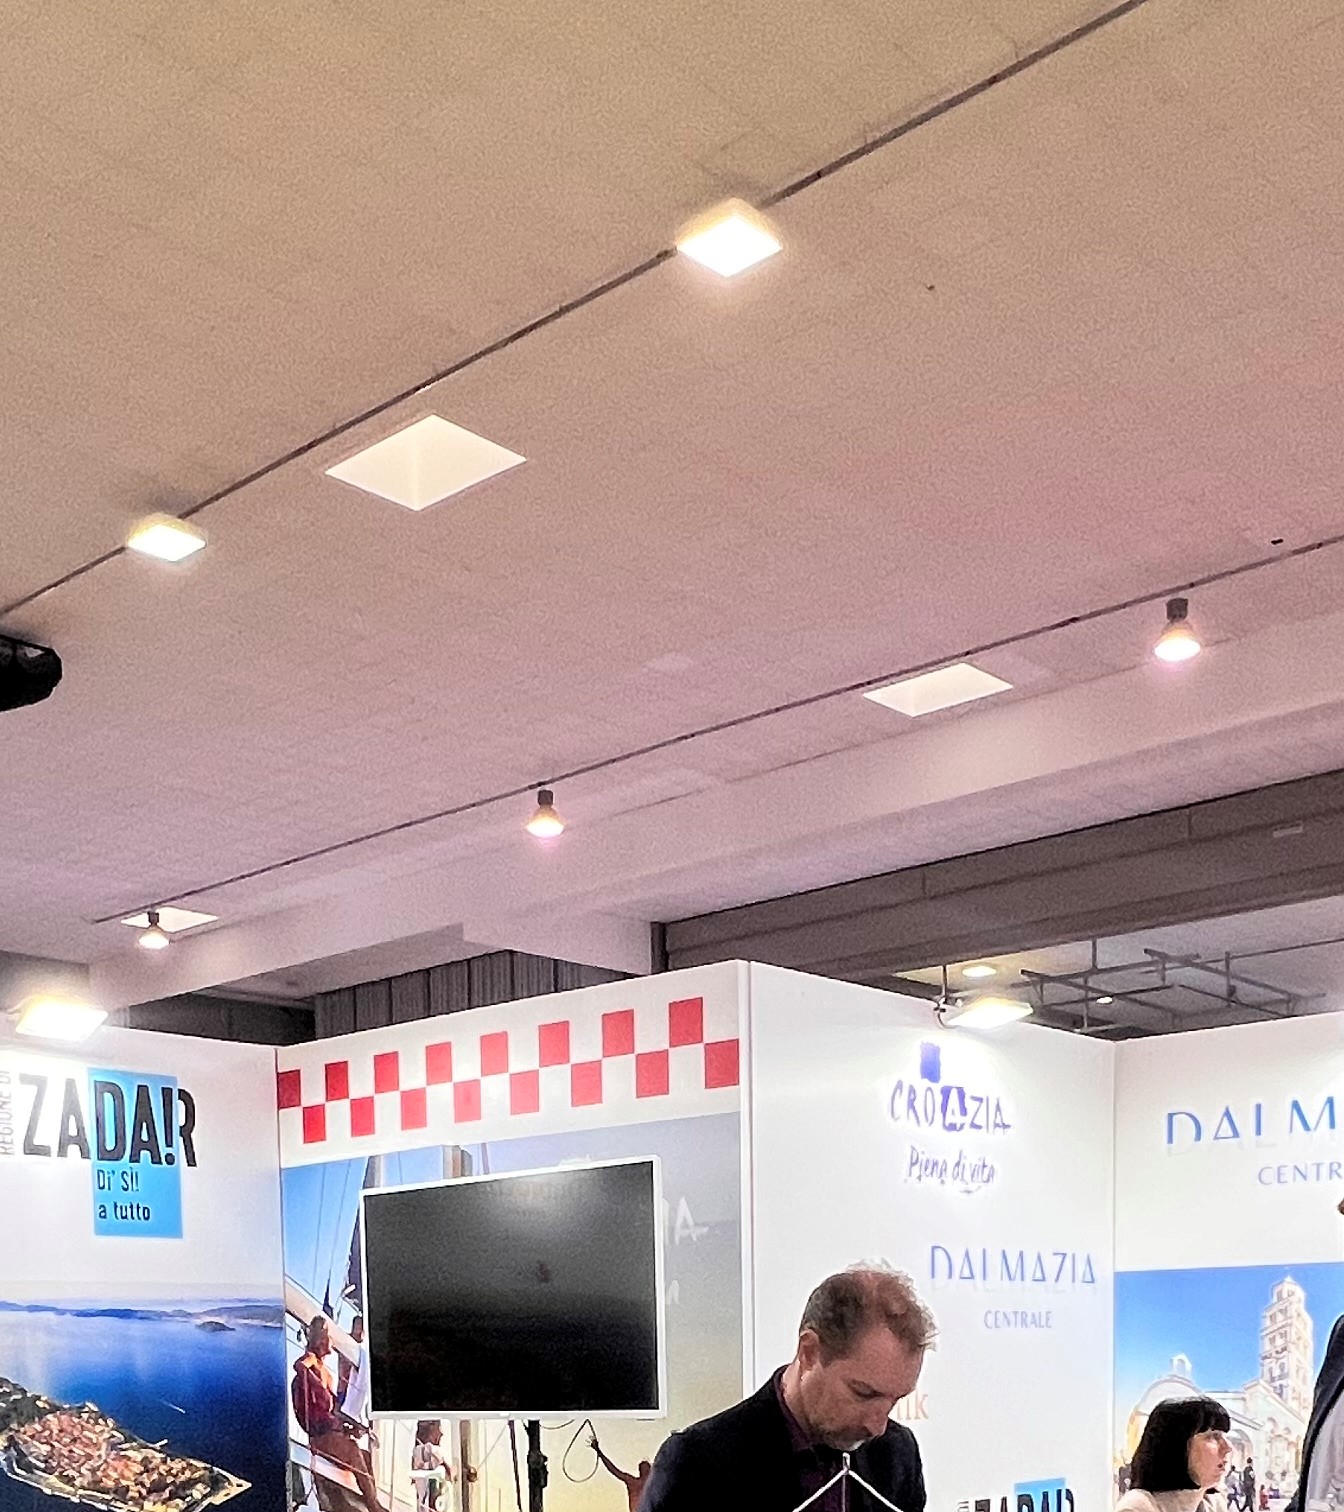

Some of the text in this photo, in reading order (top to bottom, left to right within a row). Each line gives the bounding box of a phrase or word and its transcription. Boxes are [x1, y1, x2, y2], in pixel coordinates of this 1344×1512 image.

[1257, 1160, 1343, 1186] CENTR
[97, 1201, 151, 1222] a tutto
[930, 1245, 1096, 1285] DALMAZIA
[983, 1309, 1053, 1330] CENTRALE
